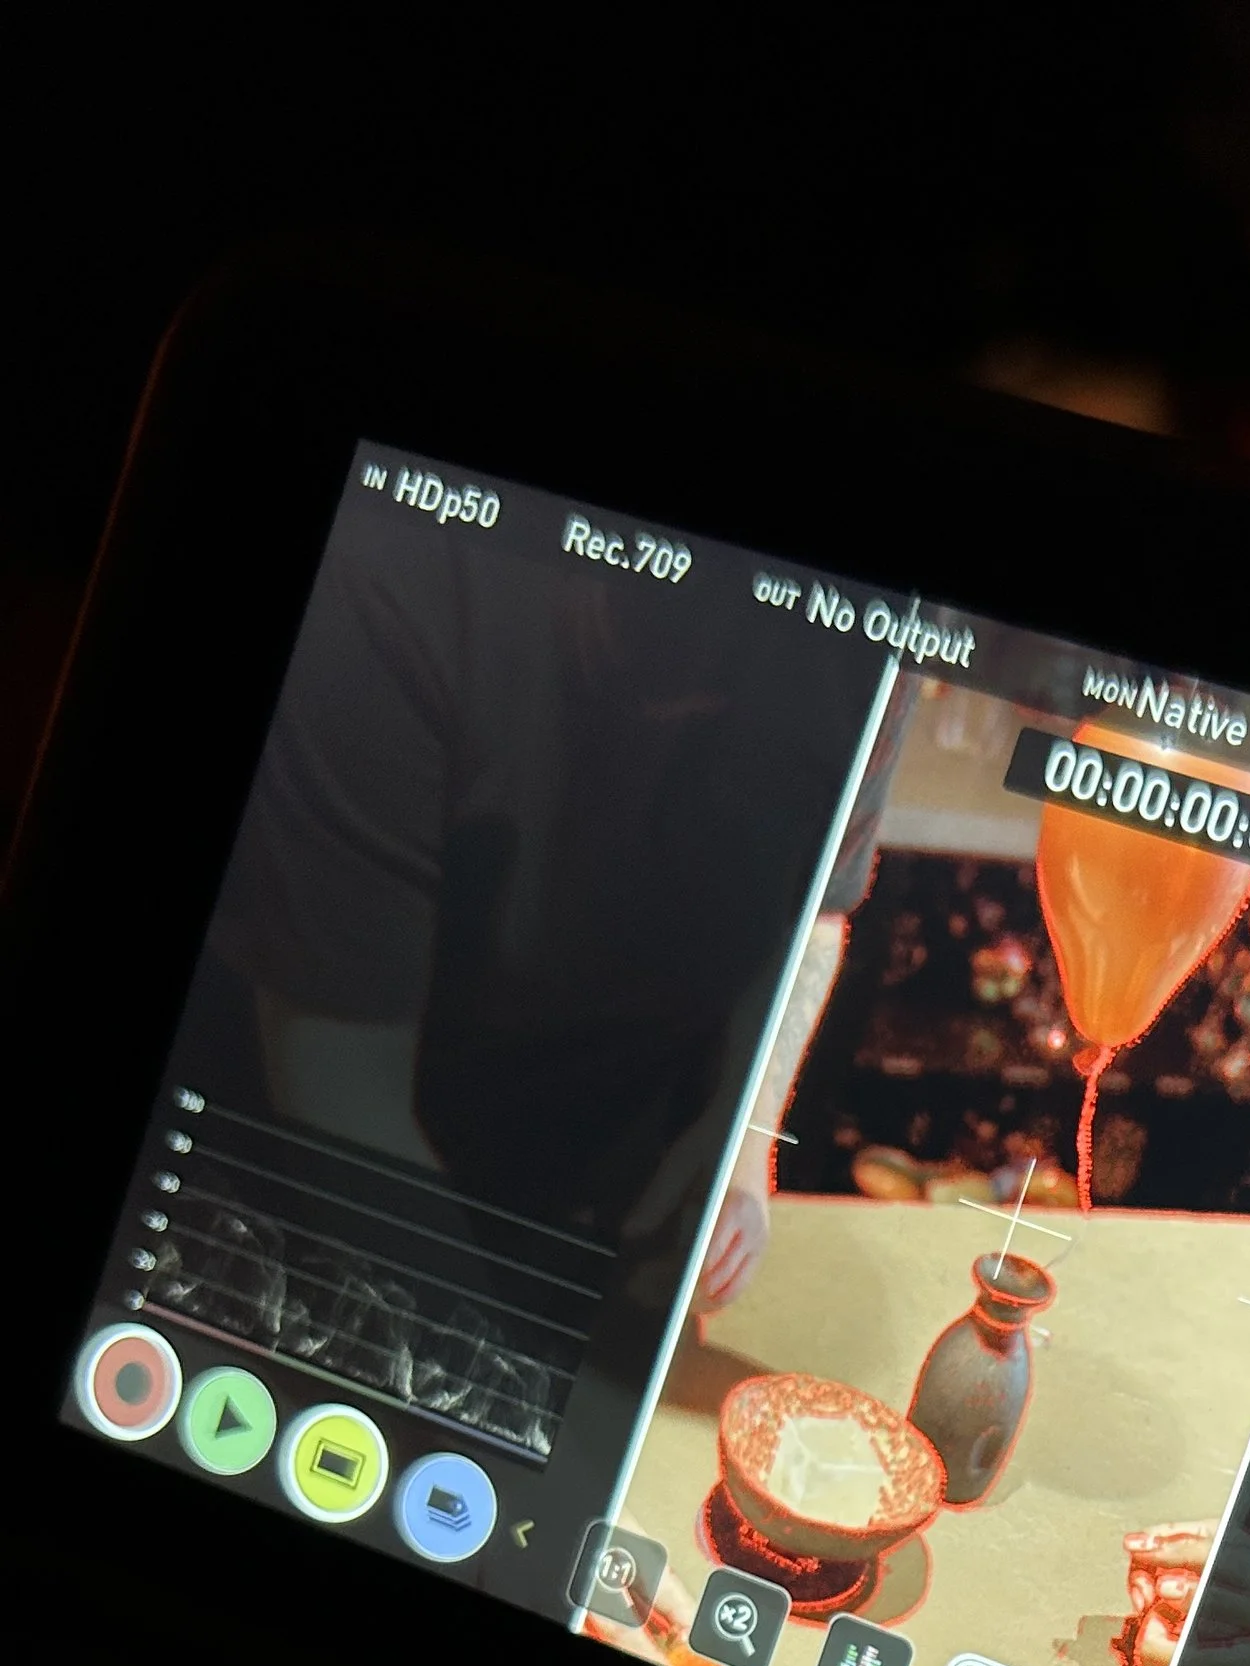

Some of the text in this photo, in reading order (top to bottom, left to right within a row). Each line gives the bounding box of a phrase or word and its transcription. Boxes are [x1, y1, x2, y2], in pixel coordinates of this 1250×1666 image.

[363, 464, 501, 528] IN HDp50
[562, 514, 692, 583] Rec.709
[754, 574, 976, 668] OUT No Output
[1082, 668, 1248, 747] MON Native
